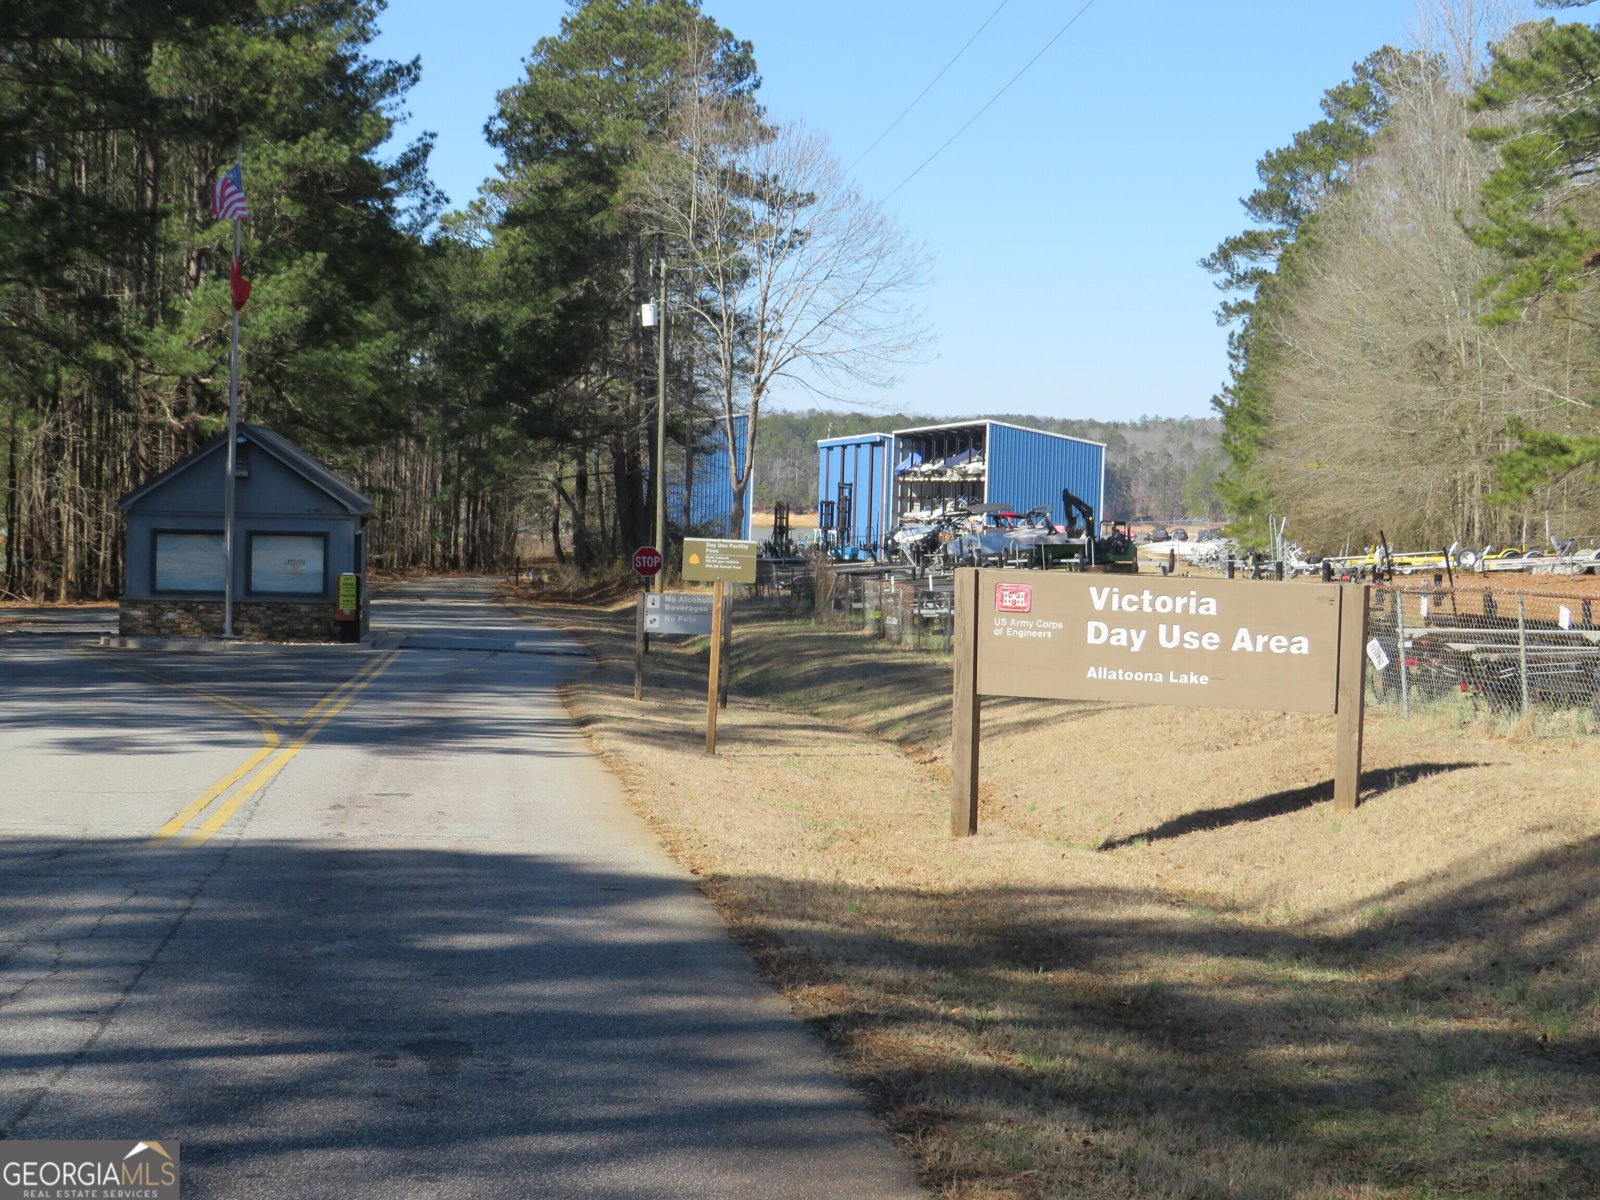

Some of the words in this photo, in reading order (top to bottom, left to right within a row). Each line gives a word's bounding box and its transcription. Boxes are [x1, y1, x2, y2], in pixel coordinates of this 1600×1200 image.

[635, 556, 660, 568] STOP
[664, 595, 677, 603] No
[1089, 586, 1217, 616] Victoria
[664, 604, 709, 613] Beverages
[664, 615, 676, 623] No
[678, 615, 697, 623] Pets
[993, 617, 1008, 626] US
[1010, 618, 1034, 629] Army
[1036, 619, 1064, 630] Corps
[993, 627, 1004, 636] of
[1007, 627, 1052, 638] Engineers
[1086, 621, 1147, 652] Day
[1158, 623, 1220, 651] Use
[1231, 627, 1309, 655] Area
[1086, 665, 1163, 683] Allatoona
[1169, 670, 1209, 685] Lake
